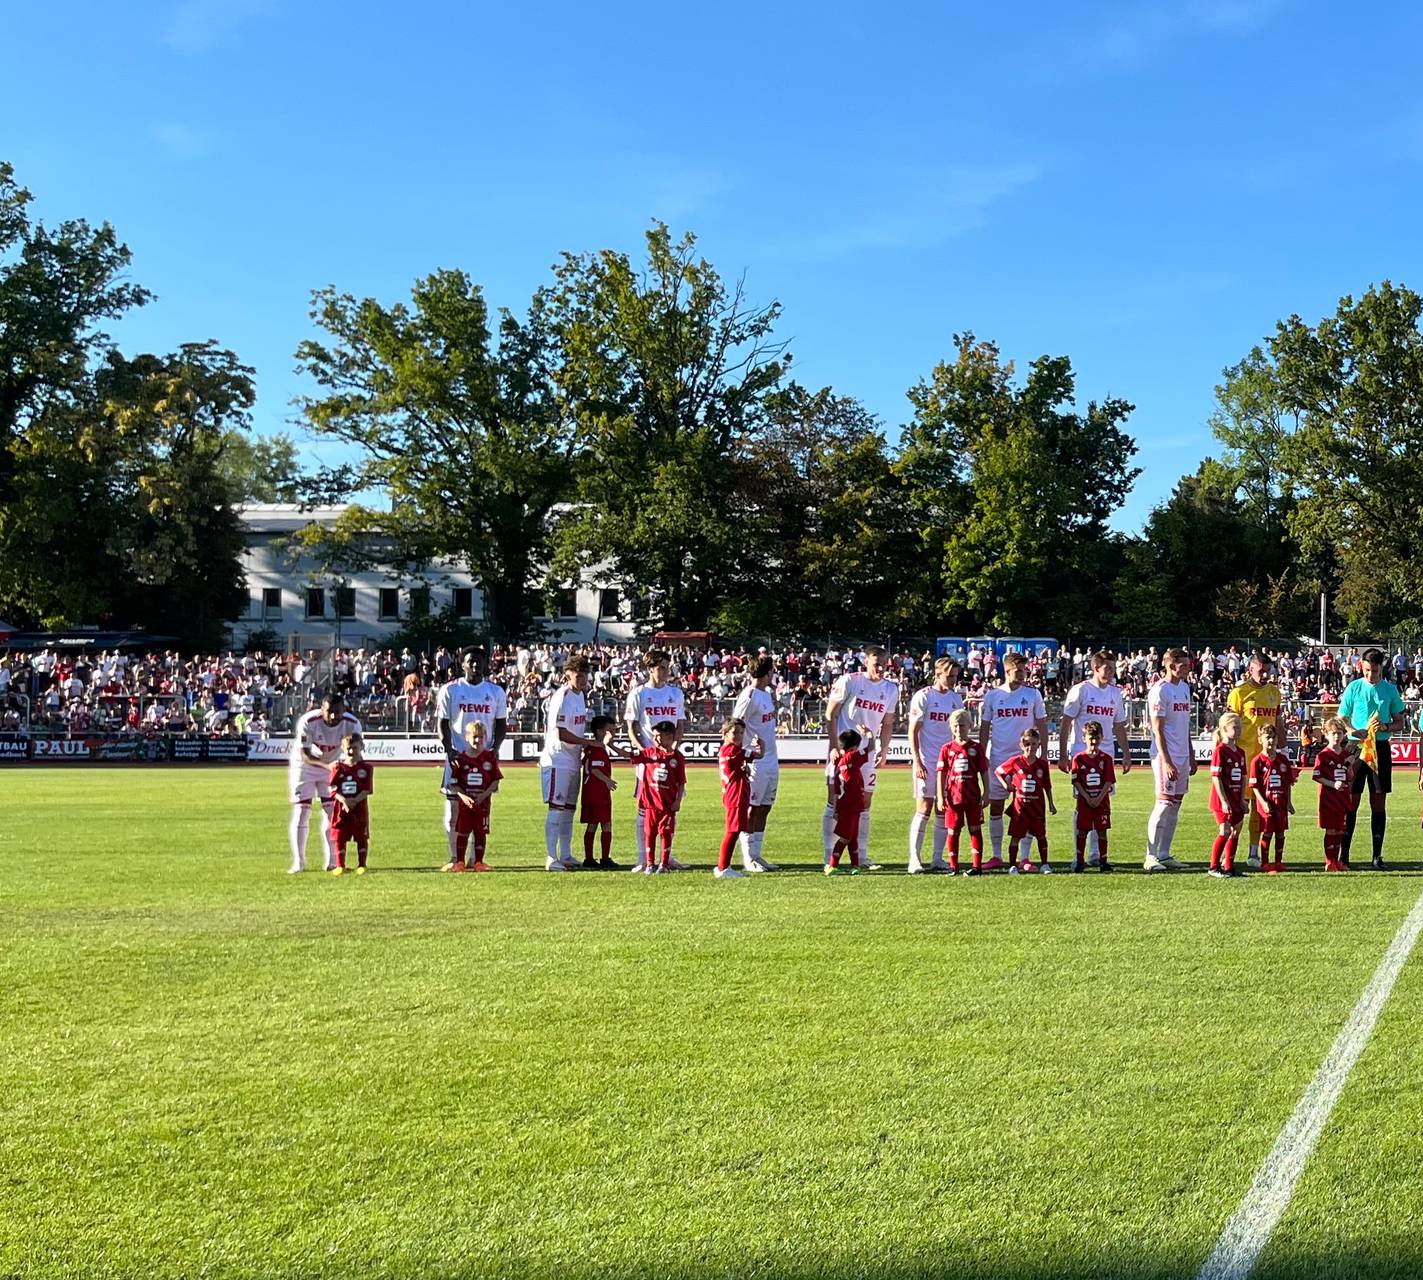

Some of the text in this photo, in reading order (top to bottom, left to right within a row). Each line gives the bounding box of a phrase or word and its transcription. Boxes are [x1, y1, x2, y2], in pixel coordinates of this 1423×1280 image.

[458, 703, 491, 714] REWE
[645, 706, 677, 716] REWE
[855, 698, 885, 713] REWE
[1086, 705, 1115, 717] REWE
[1173, 703, 1190, 712] REWE
[930, 711, 951, 722] REW
[997, 707, 1029, 718] REWE
[1250, 707, 1277, 717] REWE
[34, 740, 90, 754] PAUL
[1391, 743, 1412, 759] SV
